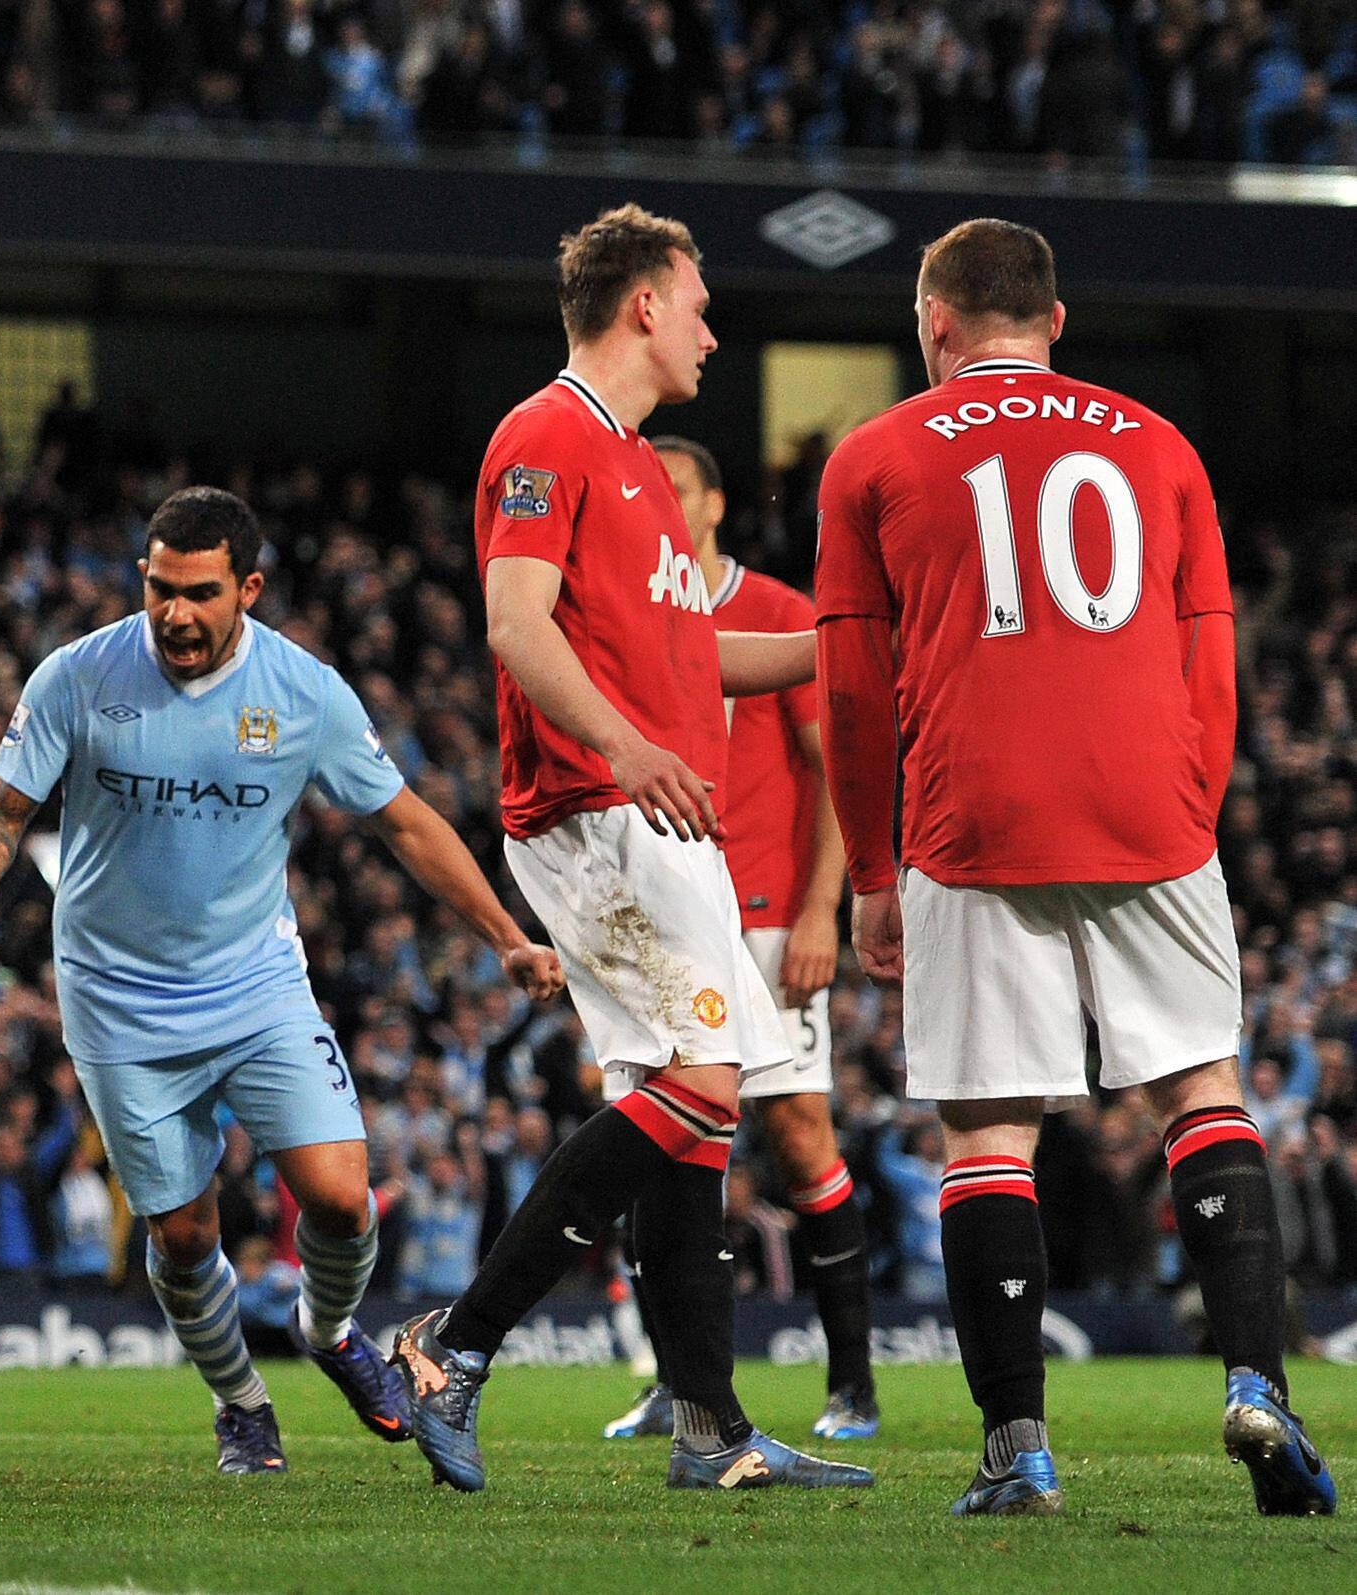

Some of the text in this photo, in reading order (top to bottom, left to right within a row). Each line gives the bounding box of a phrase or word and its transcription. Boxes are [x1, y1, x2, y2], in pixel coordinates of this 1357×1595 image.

[923, 395, 1143, 441] ROONEY
[961, 451, 1143, 638] 10
[96, 768, 270, 808] ETIHAD
[117, 801, 243, 824] AIRWAYS
[313, 1035, 348, 1091] 3
